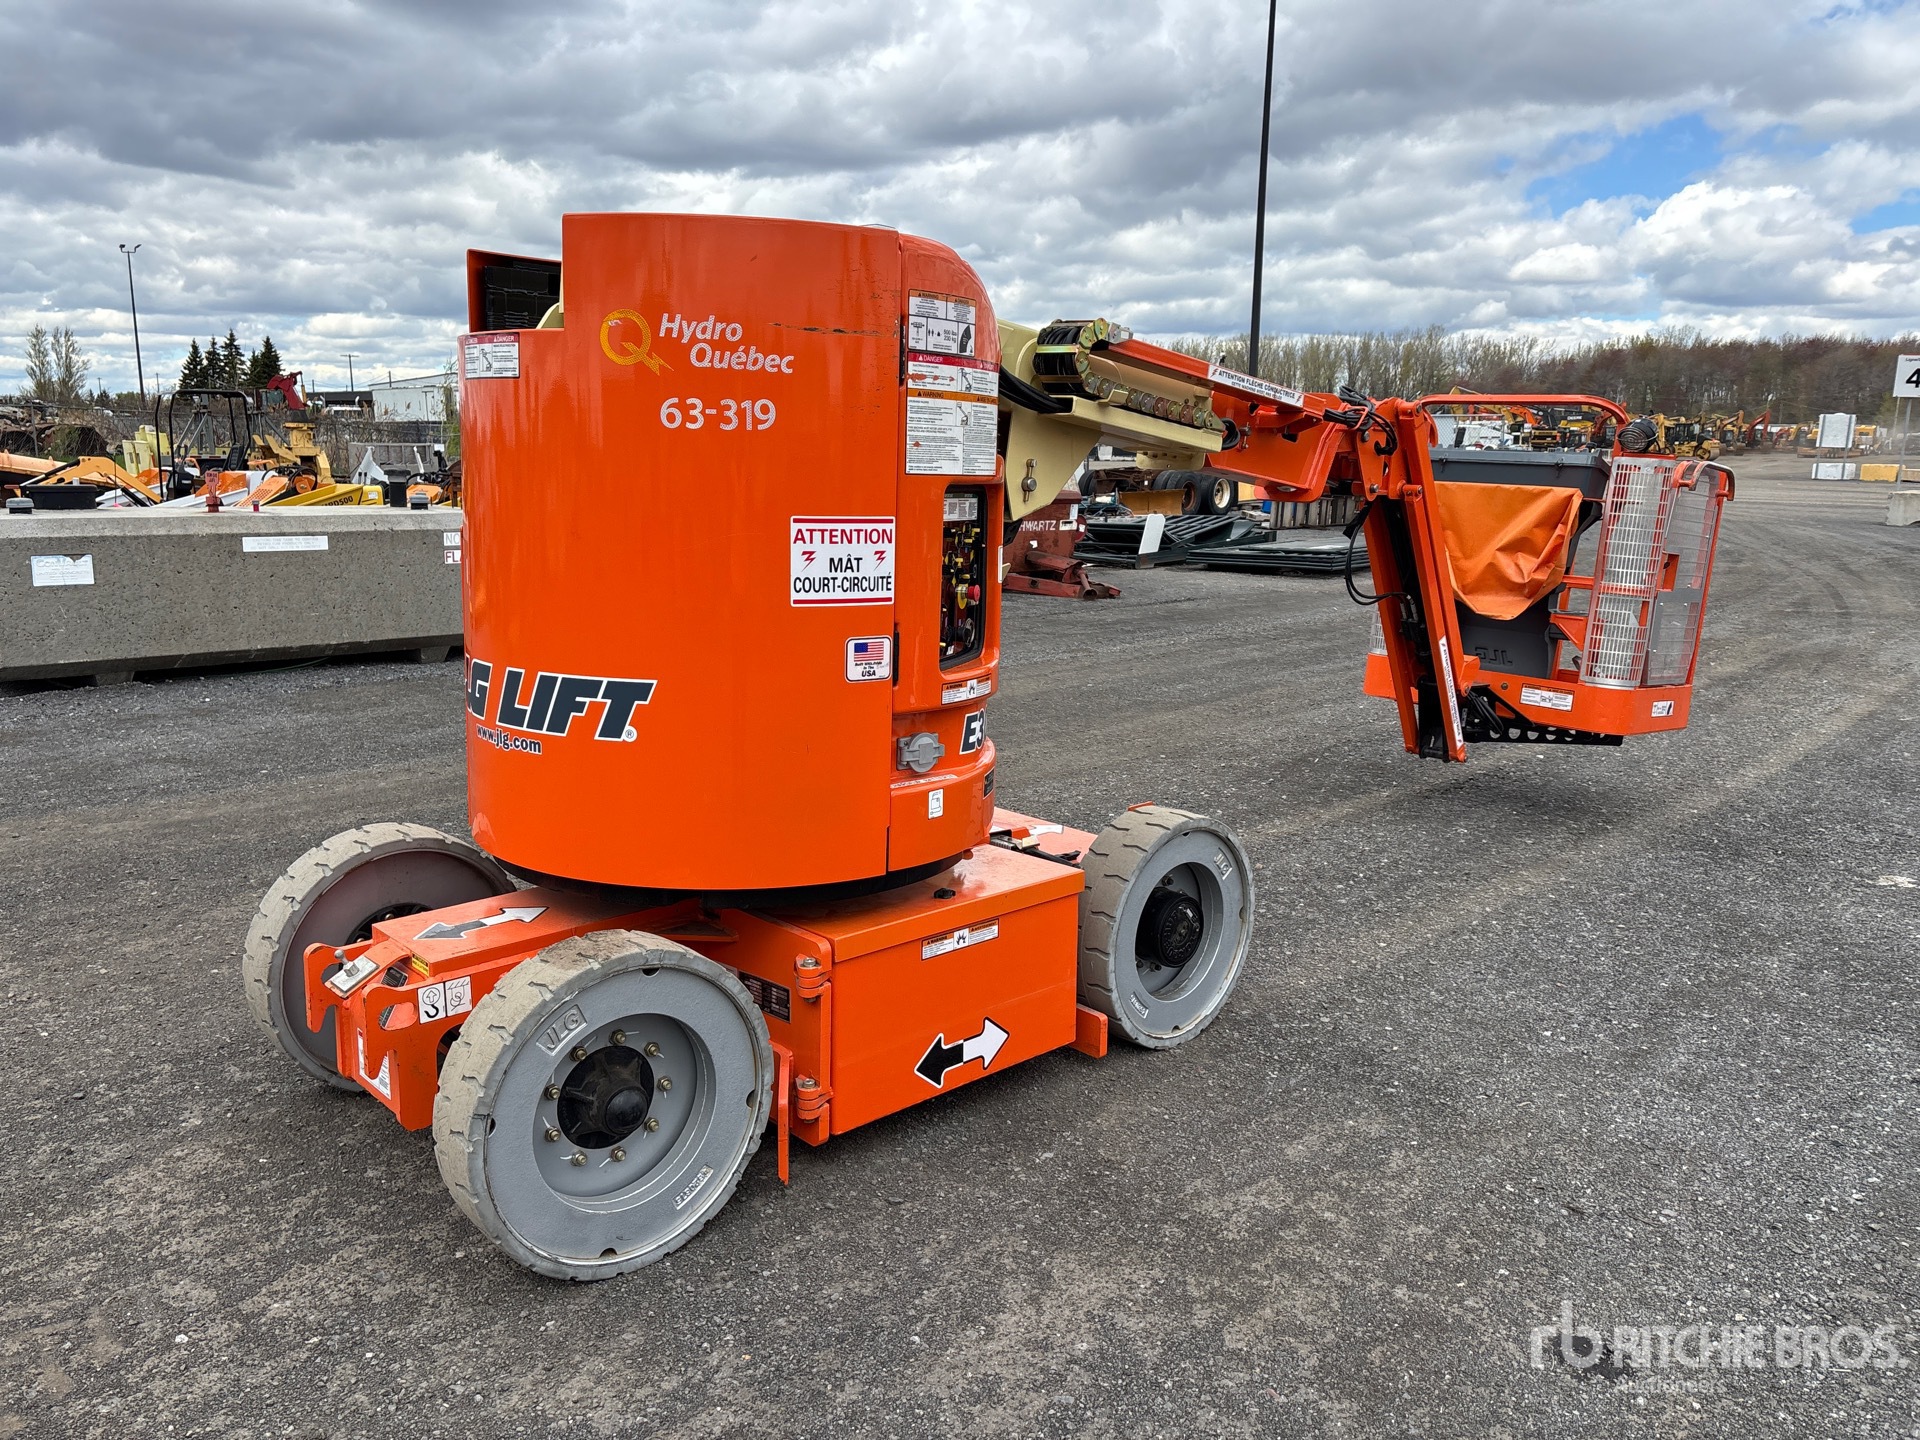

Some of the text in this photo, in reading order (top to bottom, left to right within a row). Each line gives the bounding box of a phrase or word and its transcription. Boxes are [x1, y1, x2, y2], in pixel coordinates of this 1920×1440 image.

[659, 312, 743, 343] Hydro
[689, 342, 795, 374] Québec
[923, 355, 943, 363] DANGER
[1218, 370, 1246, 384] ATTENTION
[1905, 368, 1920, 389] 4
[922, 391, 944, 399] WARNING
[660, 397, 777, 431] 63-319
[793, 528, 893, 545] ATTENTION
[445, 551, 462, 563] FL
[828, 553, 863, 573] MÂT
[793, 572, 892, 593] COURT-CIRCUITÉ
[861, 670, 876, 678] USA
[496, 666, 658, 742] LIFT
[476, 724, 542, 755] www.jlg.com
[546, 1009, 581, 1050] JLG
